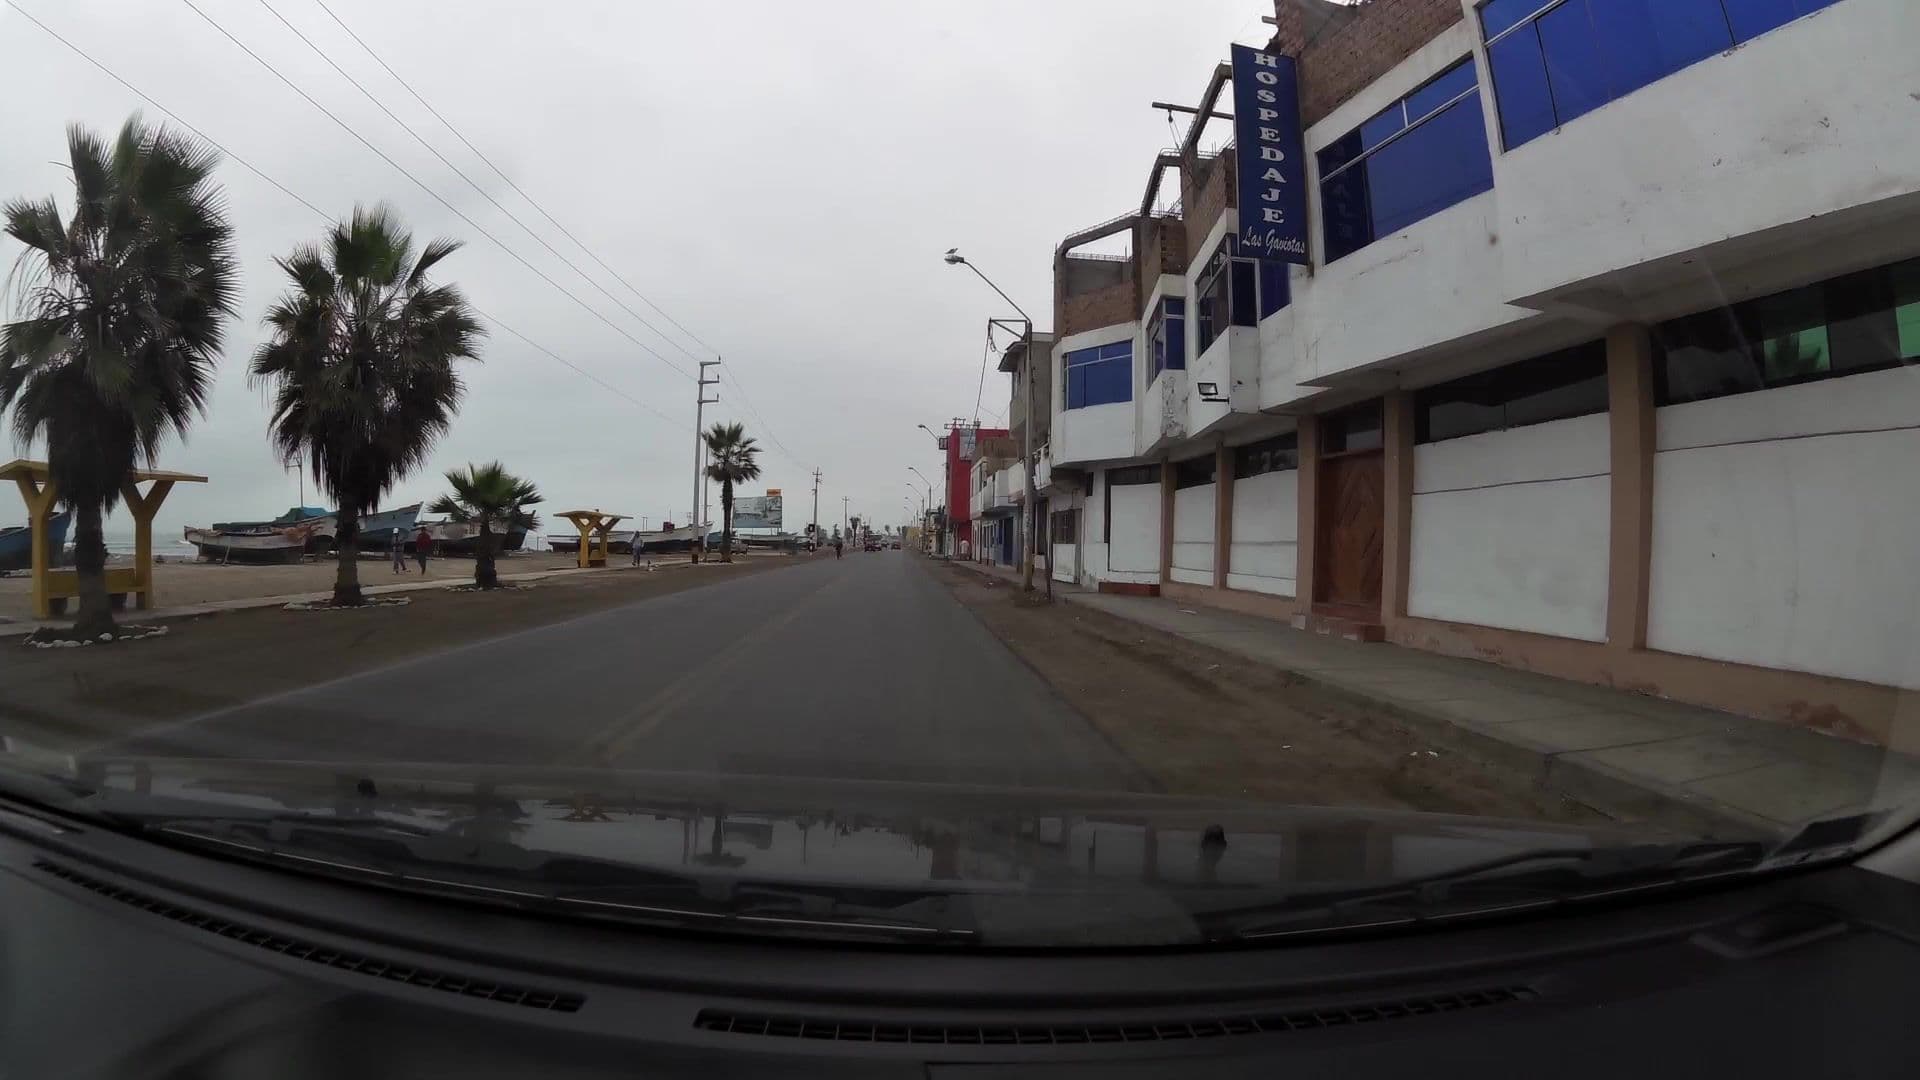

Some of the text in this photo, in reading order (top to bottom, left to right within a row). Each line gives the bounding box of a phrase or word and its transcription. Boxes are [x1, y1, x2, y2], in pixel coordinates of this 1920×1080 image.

[1254, 52, 1286, 224] HOSPEDAJE
[1242, 225, 1306, 256] Las Gaviotas
